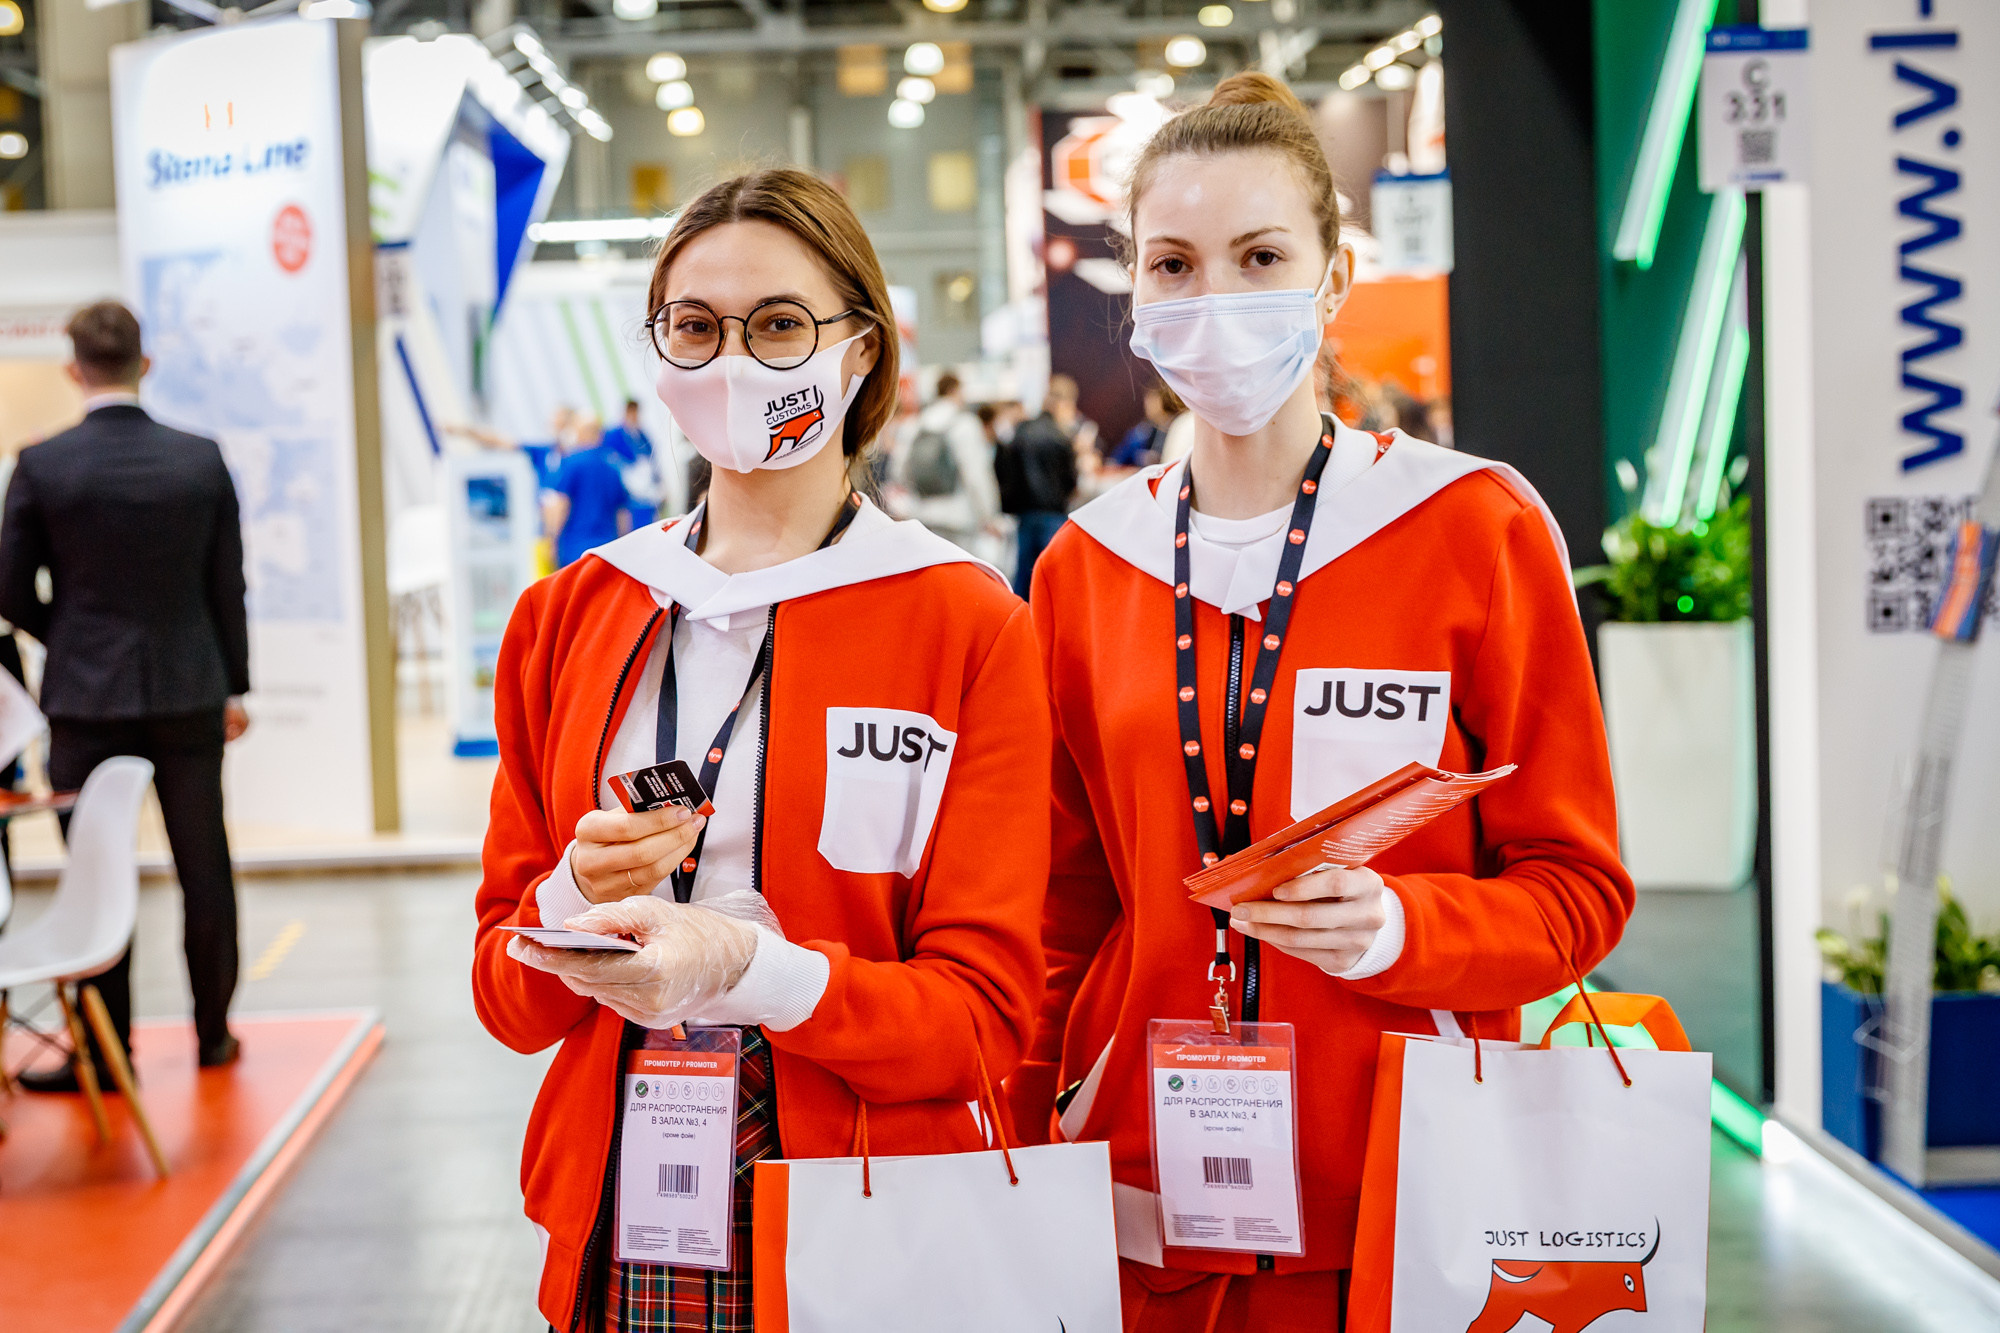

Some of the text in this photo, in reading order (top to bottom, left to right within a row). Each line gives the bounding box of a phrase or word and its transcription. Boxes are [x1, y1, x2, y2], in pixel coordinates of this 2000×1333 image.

[764, 388, 810, 416] JUST
[766, 402, 812, 425] CUSTOMS
[1303, 680, 1441, 722] JUST
[836, 722, 948, 773] JUST
[644, 1059, 681, 1068] ПРОМОУТЕР
[685, 1061, 717, 1069] PROMOTER
[1176, 1054, 1220, 1062] ПРОМОУТЕР
[1227, 1055, 1266, 1063] PROMOTER
[1163, 1096, 1283, 1108] ДЛЯ РАСПРОСТРАНЕНИЯ
[630, 1103, 727, 1114] ДЛЯ РАСПРОСТРАНЕНИЯ
[1189, 1110, 1195, 1118] В
[1198, 1110, 1229, 1119] ЗАЛАХ
[1251, 1111, 1257, 1119] 4
[651, 1116, 657, 1125] В
[659, 1117, 684, 1126] ЗАЛАХ
[702, 1118, 707, 1126] 4
[1484, 1230, 1647, 1248] JUST LOGISTICS
